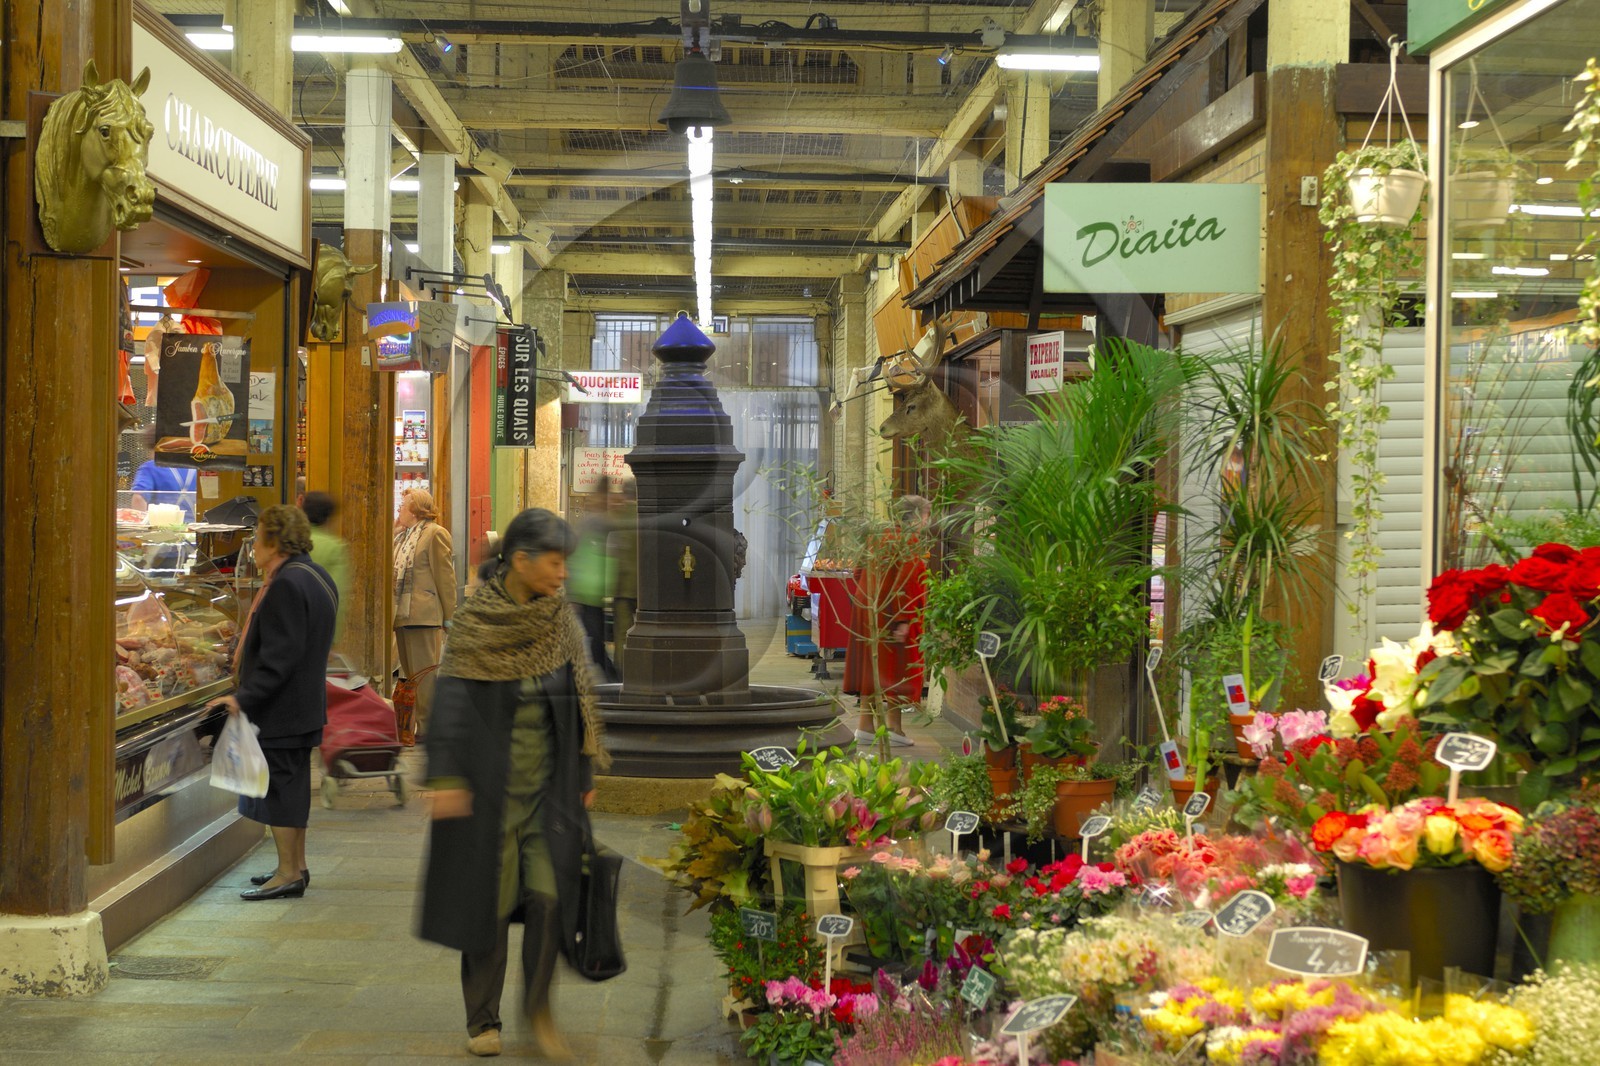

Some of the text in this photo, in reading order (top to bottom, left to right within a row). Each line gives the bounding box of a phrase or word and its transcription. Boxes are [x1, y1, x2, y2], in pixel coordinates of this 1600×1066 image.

[164, 92, 279, 211] CHARCUTERIE
[1075, 213, 1227, 268] Diaita
[165, 340, 198, 358] Jambon
[1029, 340, 1060, 366] TRIPERIE
[571, 375, 640, 389] BOUCHERIE
[1030, 367, 1058, 380] VOLAILLES
[513, 335, 530, 440] SUR LES QUAIS
[115, 762, 143, 802] Michel
[750, 923, 767, 937] 10
